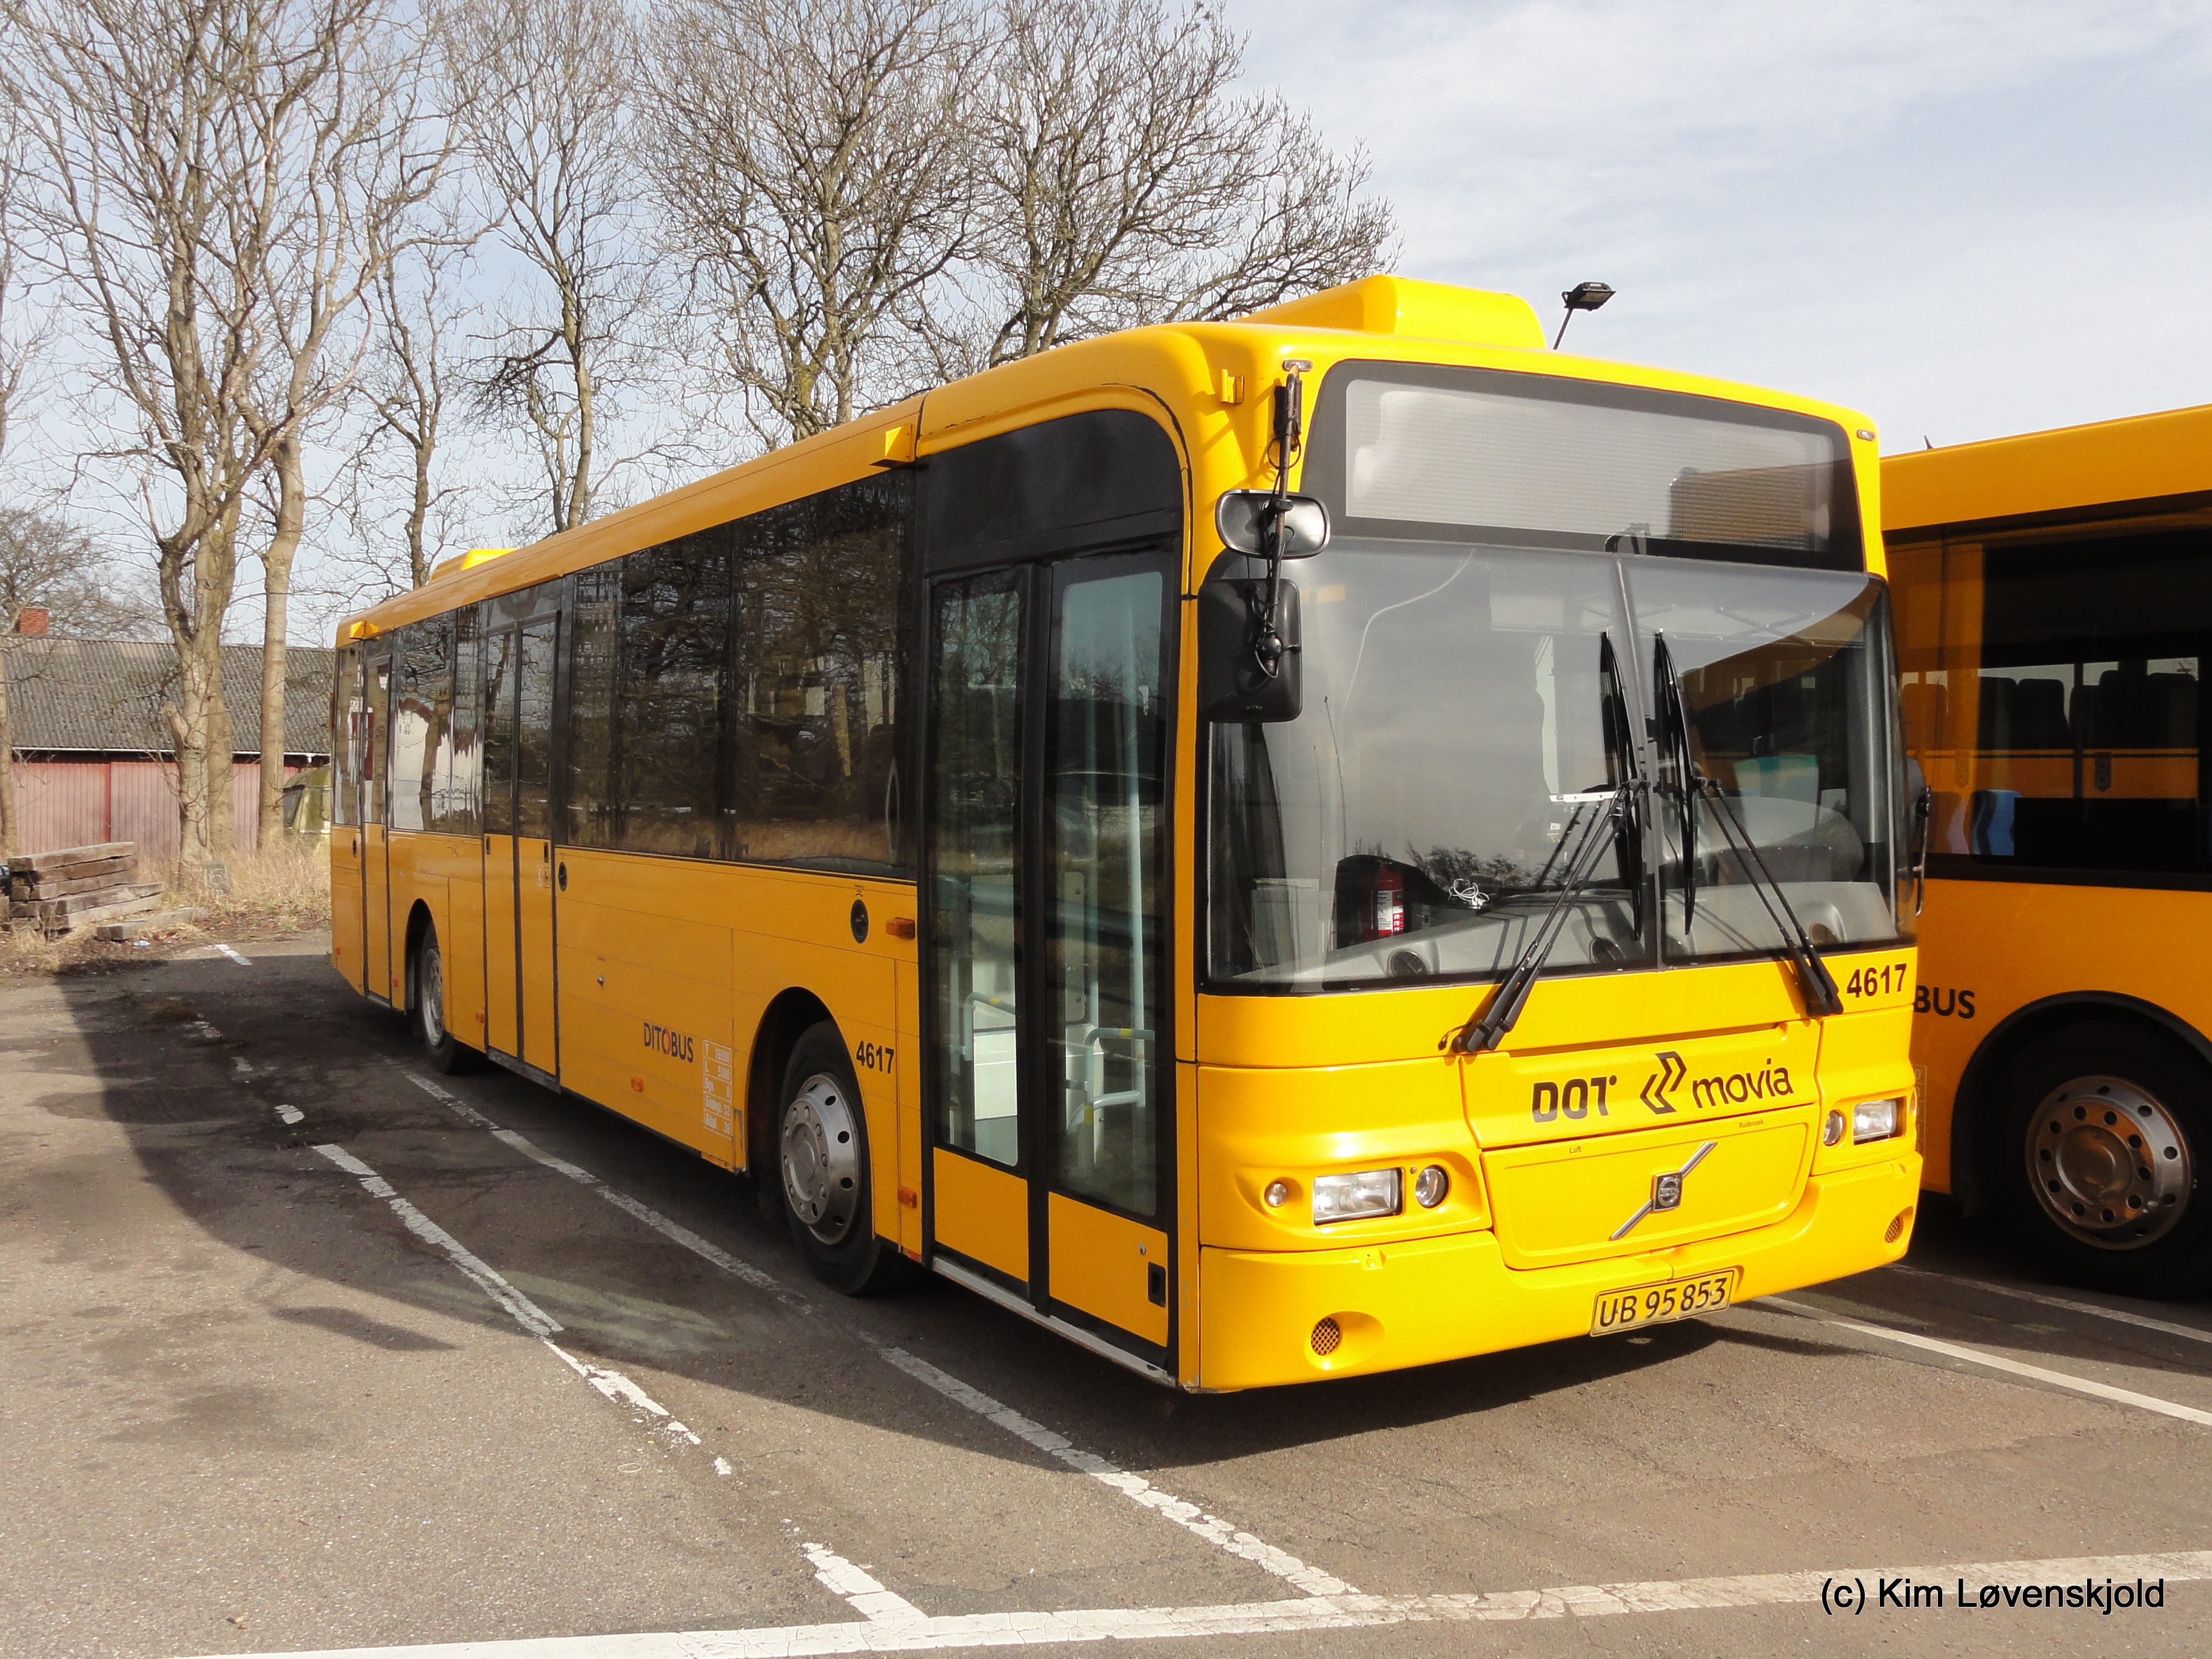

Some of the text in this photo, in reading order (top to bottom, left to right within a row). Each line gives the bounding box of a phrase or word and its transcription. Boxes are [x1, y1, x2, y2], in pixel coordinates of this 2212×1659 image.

[1846, 963, 1907, 998] 4617
[1914, 985, 1976, 1019] BUS
[643, 1022, 694, 1063] DITOBUS
[705, 1043, 709, 1056] T
[856, 1040, 894, 1074] 4617
[705, 1059, 709, 1073] L
[1692, 1058, 1794, 1109] movia
[1532, 1075, 1617, 1123] DOT
[1600, 1277, 1728, 1327] UB 95 853
